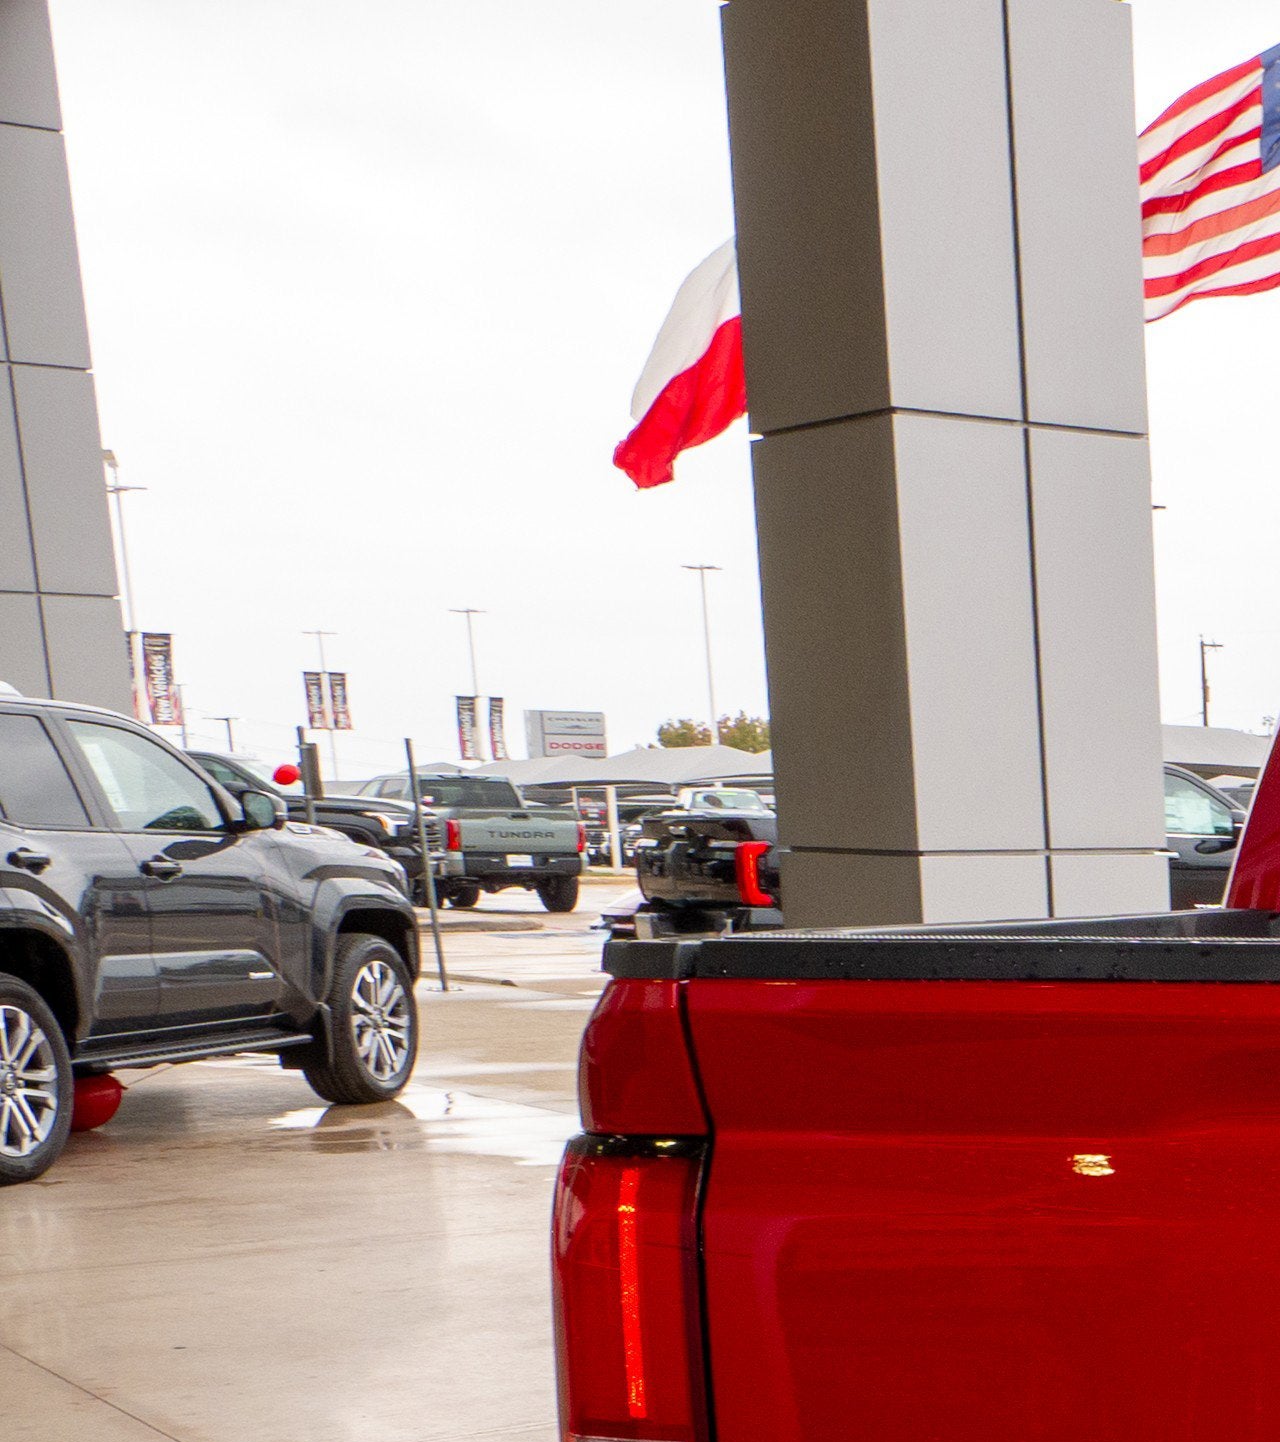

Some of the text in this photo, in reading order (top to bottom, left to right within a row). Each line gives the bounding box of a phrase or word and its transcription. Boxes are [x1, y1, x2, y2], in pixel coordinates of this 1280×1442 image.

[149, 654, 173, 722] New Vehicles
[550, 742, 605, 750] DODGE
[488, 830, 555, 839] TUNDRA
